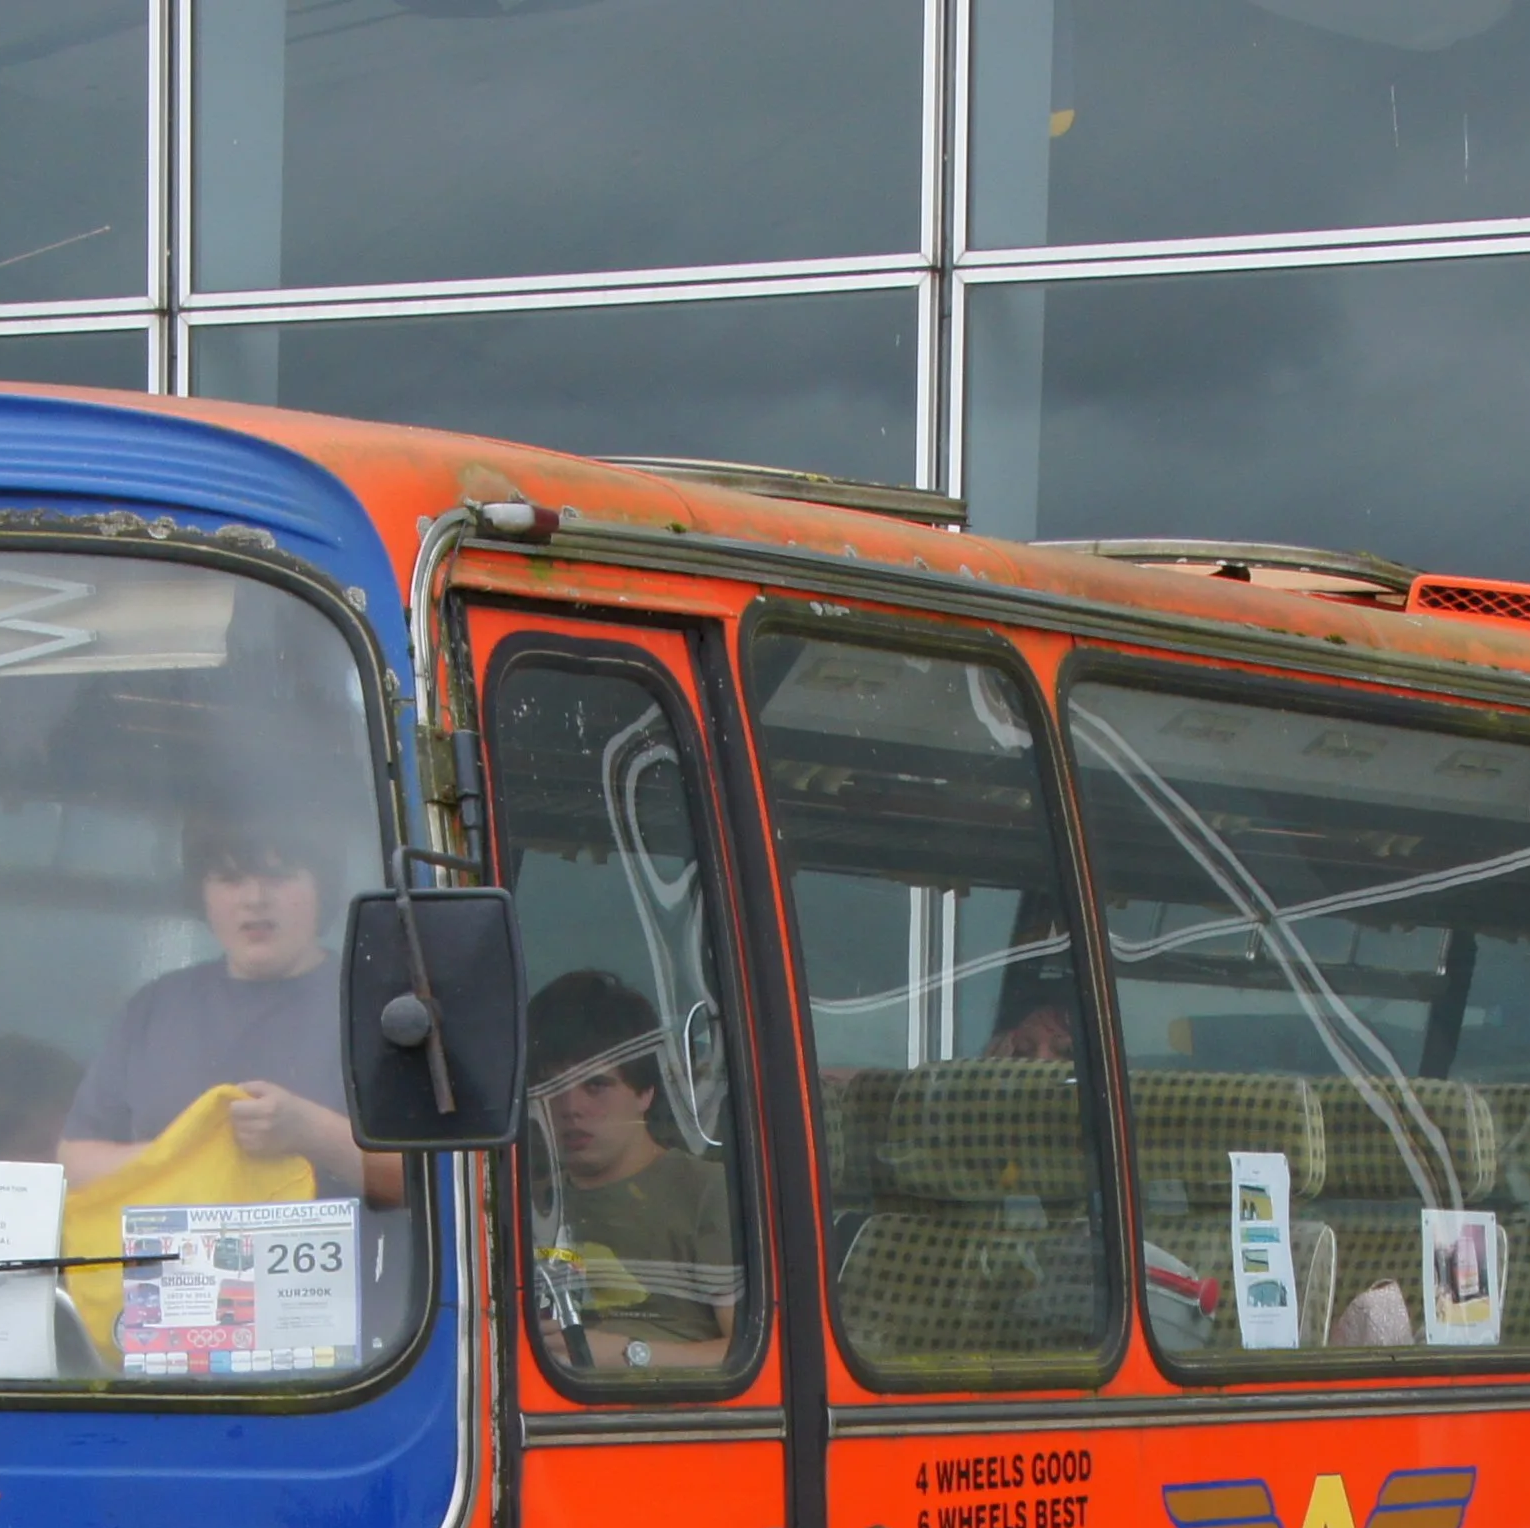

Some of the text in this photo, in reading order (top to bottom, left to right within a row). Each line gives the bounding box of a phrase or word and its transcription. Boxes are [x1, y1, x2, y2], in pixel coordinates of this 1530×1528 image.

[189, 1203, 352, 1223] WWW.TTCDIECAST.COM
[266, 1241, 343, 1275] 263
[276, 1287, 333, 1298] XUR290K
[915, 1449, 1092, 1496] 4 WHEELS GOOD
